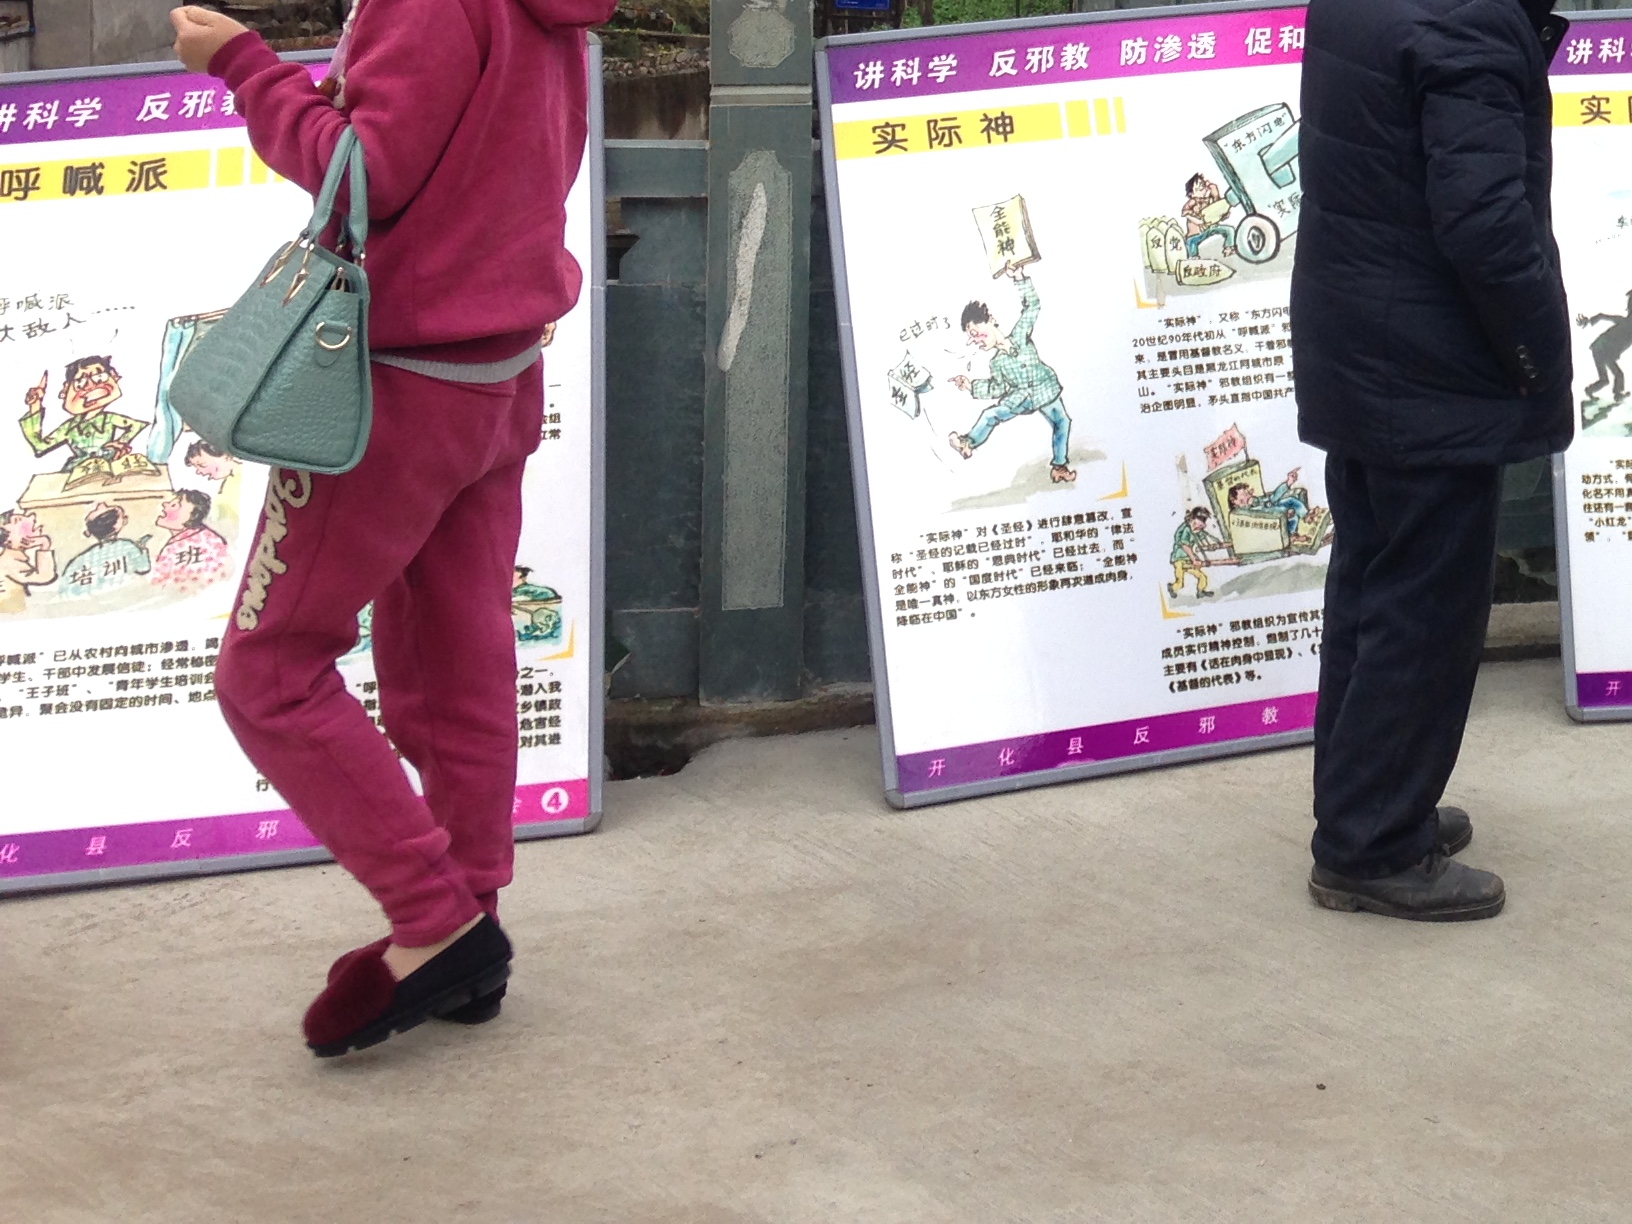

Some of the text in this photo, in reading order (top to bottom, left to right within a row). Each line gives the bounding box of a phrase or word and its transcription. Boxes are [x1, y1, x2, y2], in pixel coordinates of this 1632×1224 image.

[854, 24, 1305, 90] 讲科学 反邪教 防渗透 促和
[871, 111, 1015, 155] 实际神
[0, 157, 168, 201] 呼喊派
[990, 205, 1016, 256] 全能神
[928, 707, 1279, 777] 开化县反邪教
